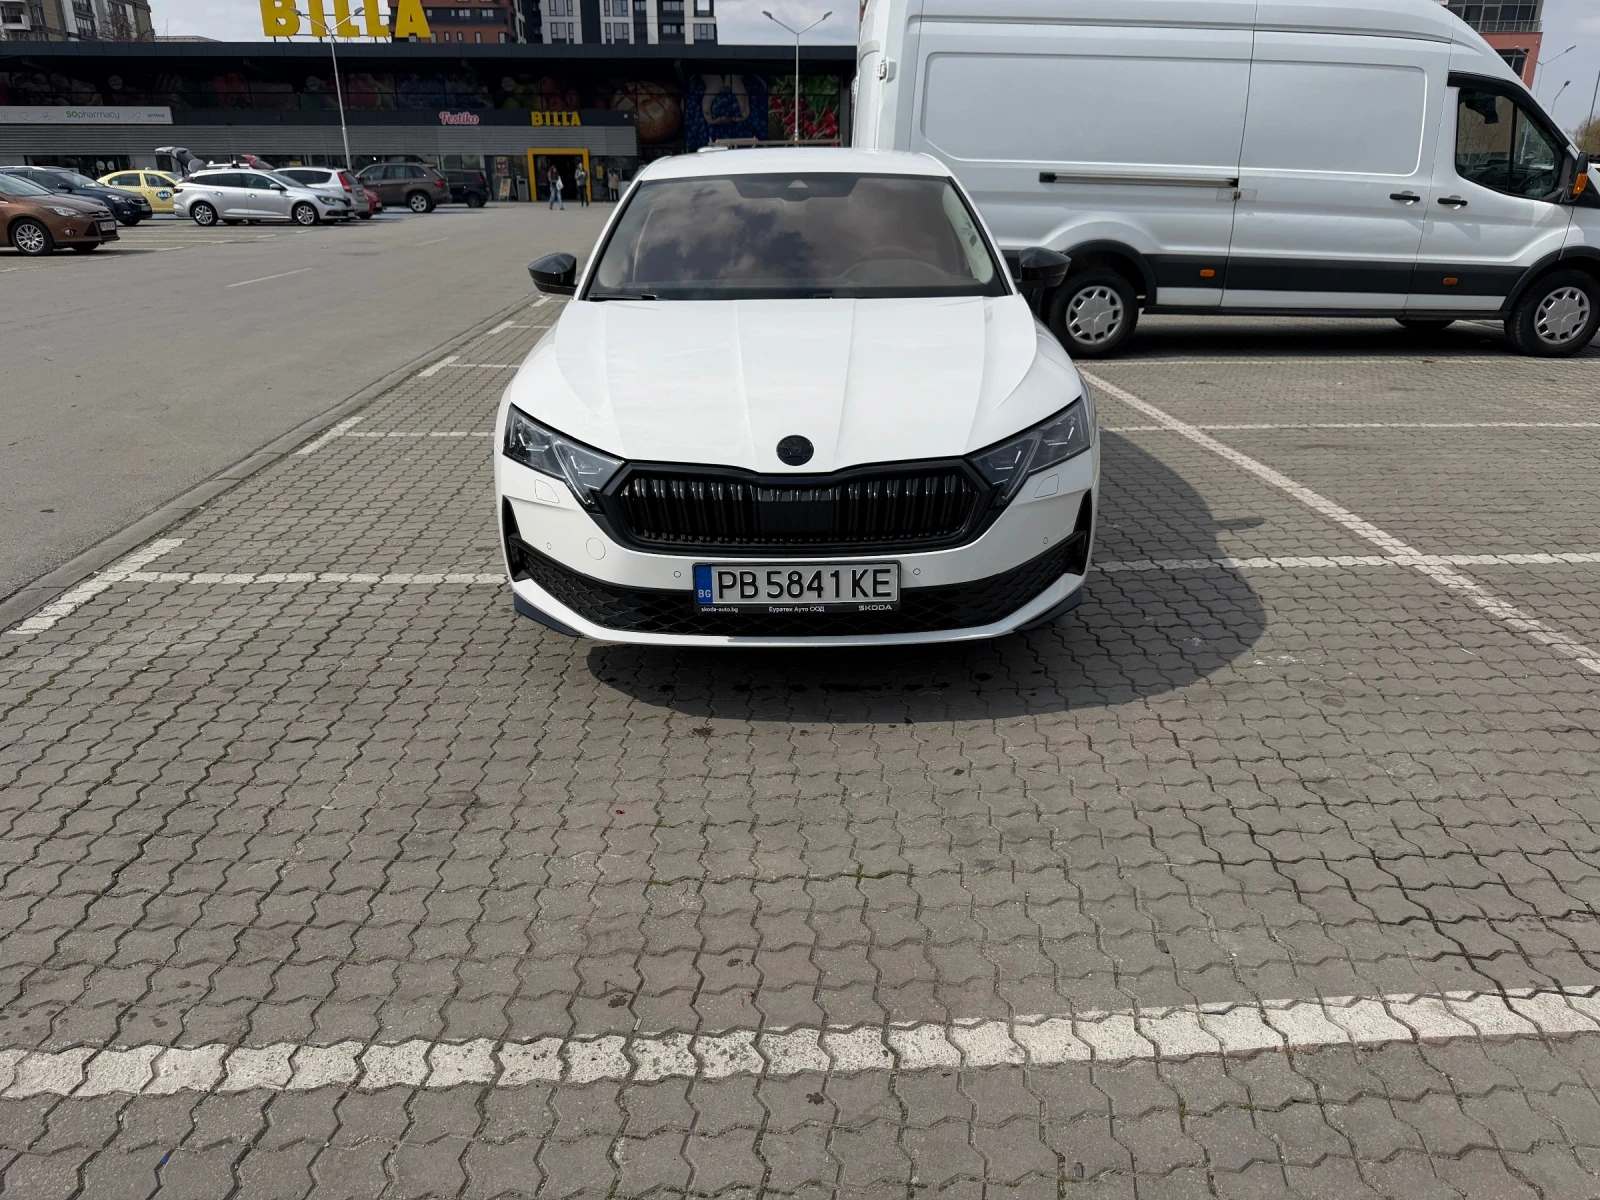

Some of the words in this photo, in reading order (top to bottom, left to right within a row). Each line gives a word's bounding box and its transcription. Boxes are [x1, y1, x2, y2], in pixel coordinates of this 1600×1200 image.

[260, 0, 432, 38] BILLA
[439, 111, 479, 125] Festiko
[531, 111, 581, 126] BILLA
[717, 570, 758, 599] PB
[766, 569, 840, 598] 5841
[851, 568, 892, 597] KE
[698, 589, 711, 598] BG
